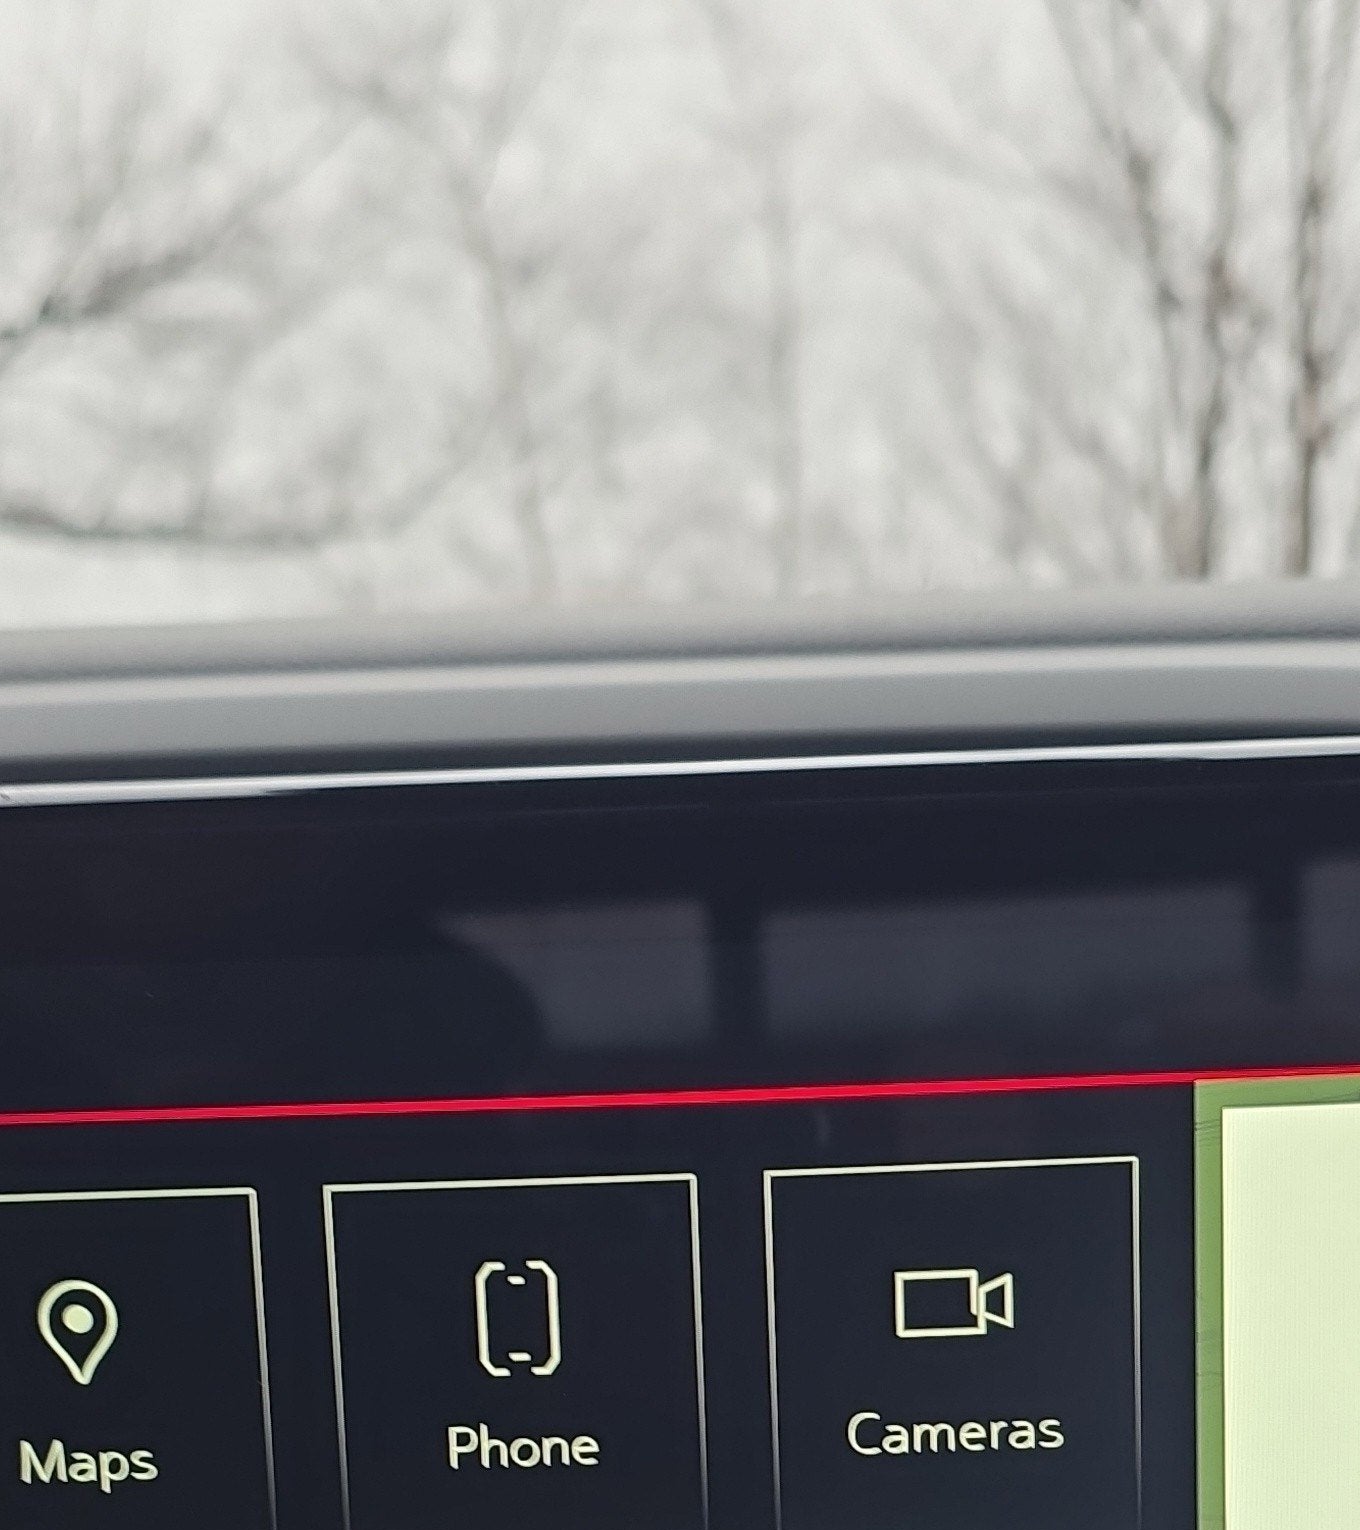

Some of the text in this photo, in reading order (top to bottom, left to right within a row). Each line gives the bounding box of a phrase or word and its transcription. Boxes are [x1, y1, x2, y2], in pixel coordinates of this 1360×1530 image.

[448, 1422, 600, 1470] Phone
[847, 1410, 1065, 1456] Cameras
[19, 1439, 159, 1494] Maps
